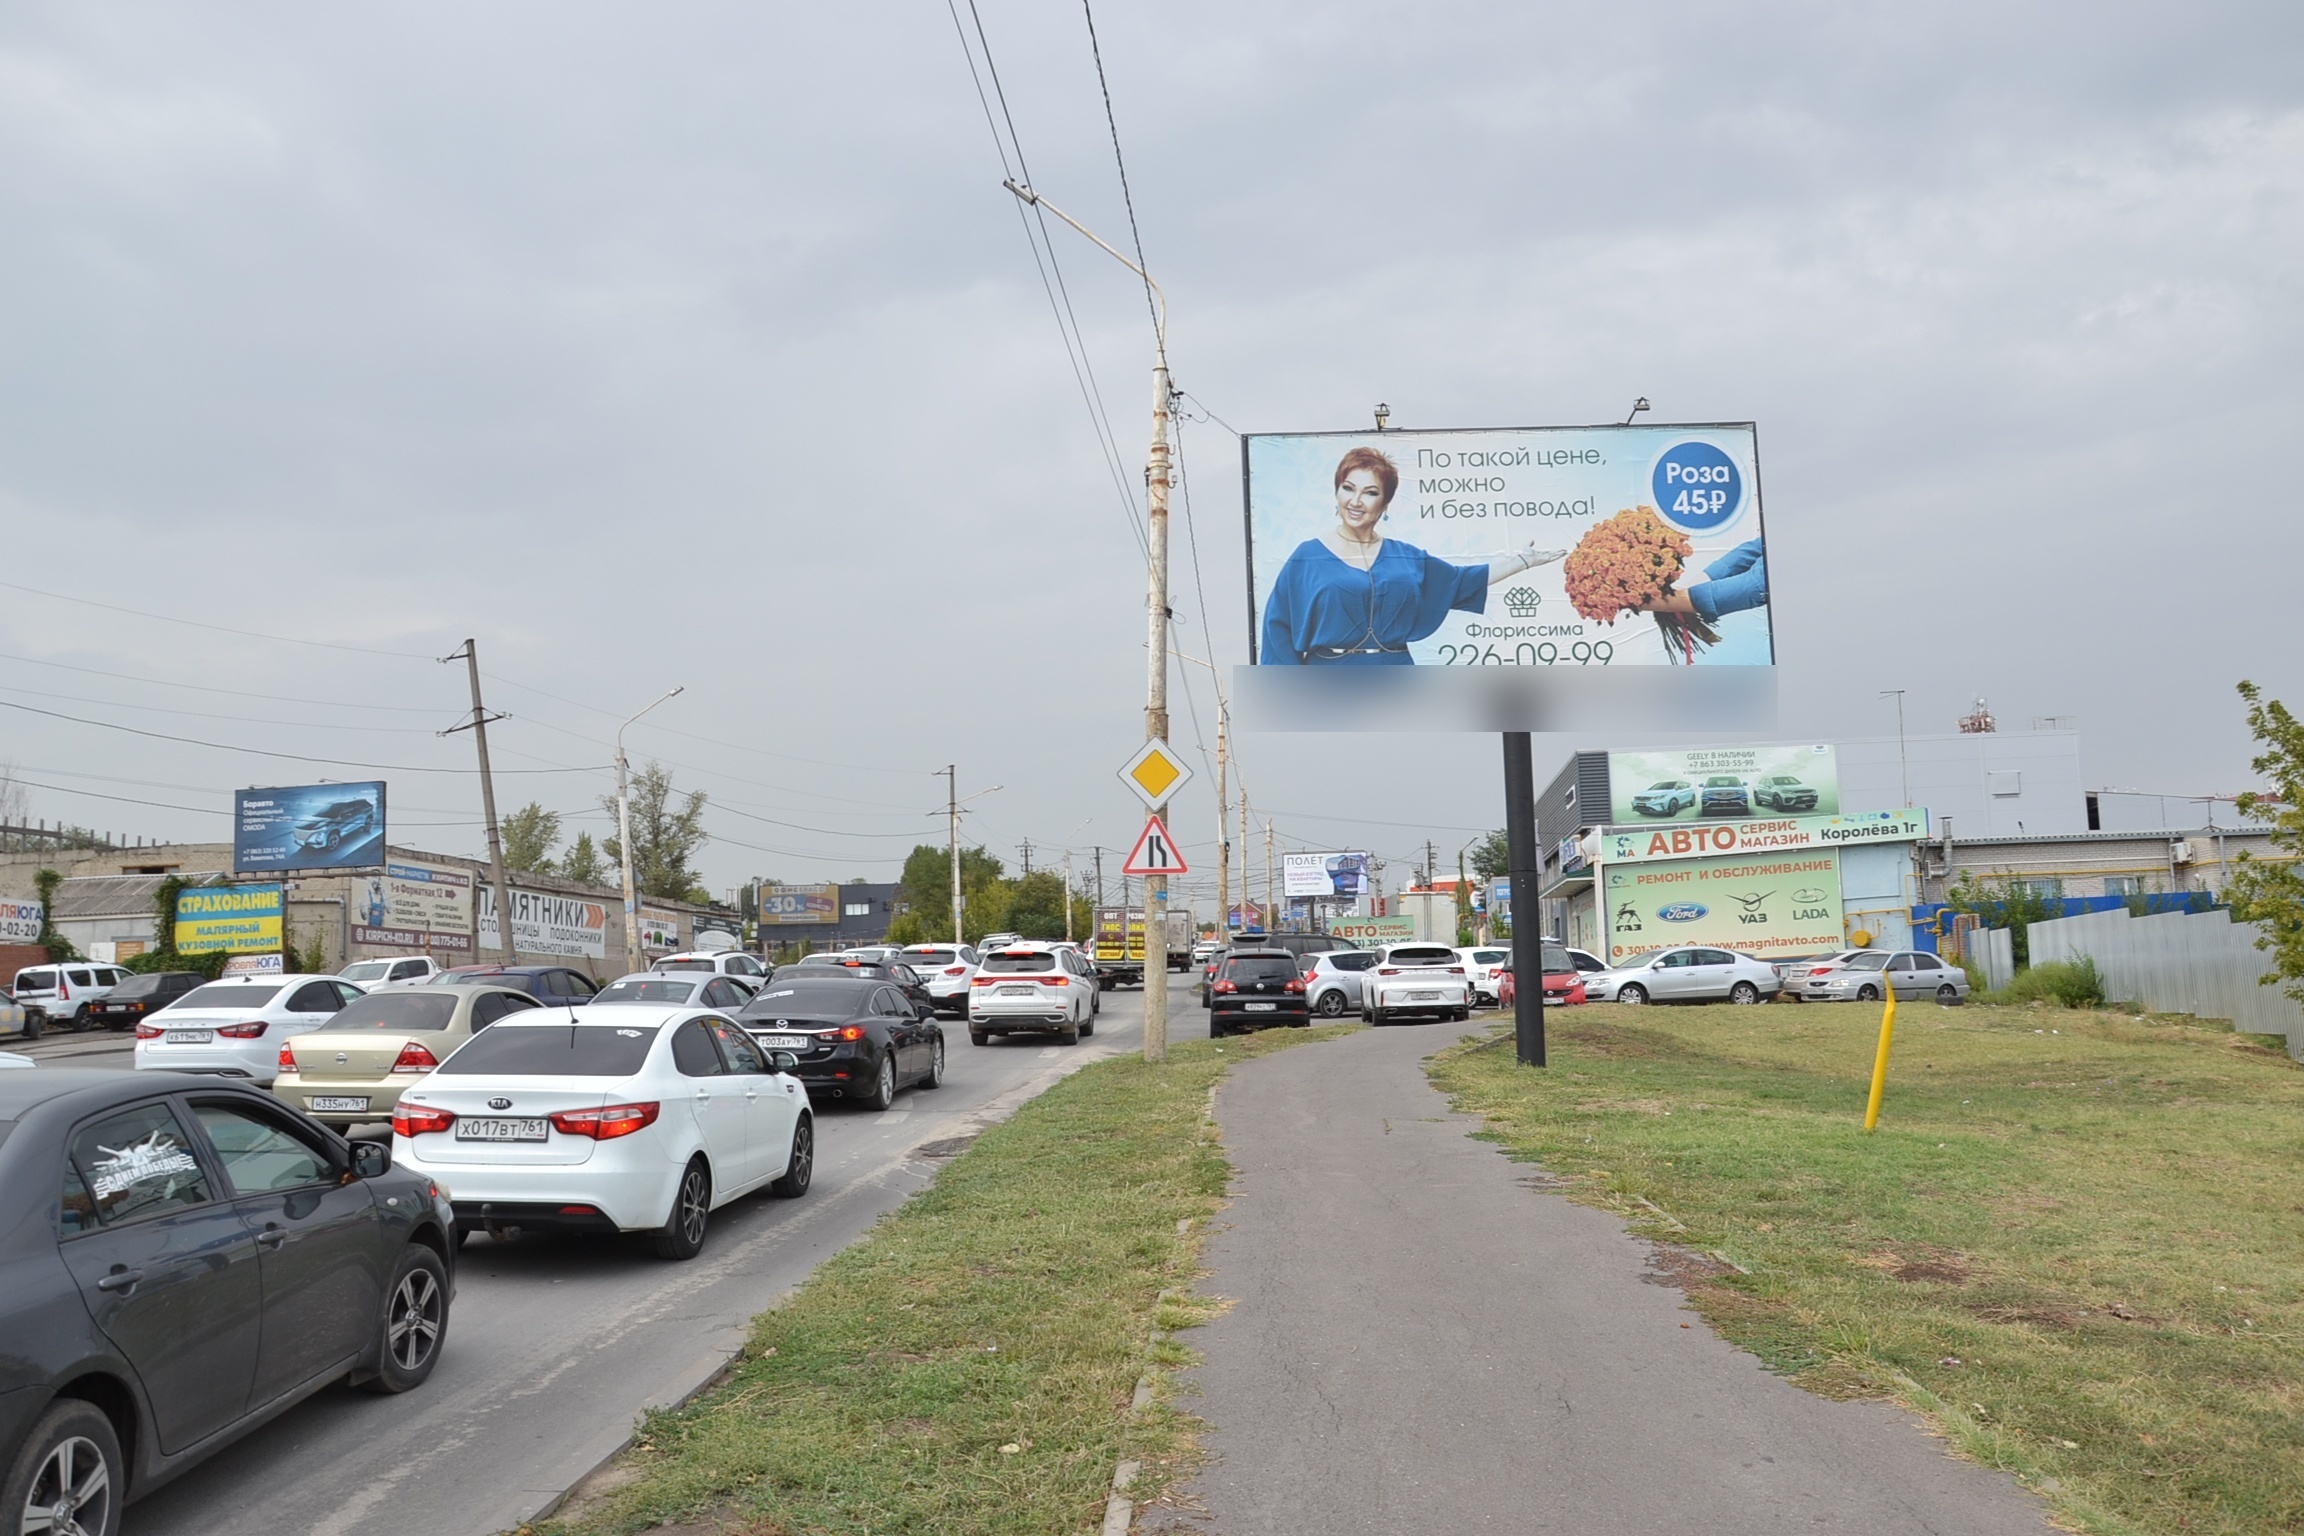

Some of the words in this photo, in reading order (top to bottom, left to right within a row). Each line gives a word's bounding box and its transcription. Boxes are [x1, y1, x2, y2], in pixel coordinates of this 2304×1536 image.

[1418, 449, 1451, 468] По
[1458, 446, 1530, 467] такой
[1537, 449, 1606, 468] цене,
[1666, 462, 1730, 484] Роза
[1419, 476, 1505, 493] можно
[1420, 504, 1435, 519] и
[1441, 499, 1487, 519] без
[1494, 496, 1595, 519] повода!
[1466, 622, 1583, 640] Флориссима
[1718, 751, 1755, 759] НАЛИЧИИ
[1716, 759, 1754, 767] 303-55-99
[1647, 826, 1736, 855] АВТО
[1740, 820, 1797, 835] СЕРВИС
[1821, 824, 1899, 841] Королёва
[1902, 822, 1918, 833] 1г
[1617, 849, 1635, 858] МА
[1740, 833, 1810, 848] МАГАЗИН
[1637, 871, 1692, 885] РЕМОНТ
[1699, 870, 1709, 880] И
[1712, 860, 1832, 879] ОБСЛУЖИВАНИЕ
[178, 891, 279, 914] СТРАХОВАНИЕ
[1666, 905, 1698, 919] Ford
[1738, 913, 1768, 924] УАЗ
[1793, 908, 1830, 920] LADA
[196, 922, 260, 936] МАЛЯРНЫЙ
[1332, 925, 1377, 938] АВТО
[1616, 924, 1642, 932] ГАЗ
[550, 927, 602, 944] ПОДОКОННИКИ
[178, 937, 235, 951] КУЗОВНОЙ
[237, 937, 279, 947] РЕМОНТ
[515, 940, 562, 954] НАТУРАЛЬНОГО
[563, 944, 583, 955] КАМНЯ
[490, 1099, 509, 1108] KIA
[521, 1120, 544, 1132] 761
